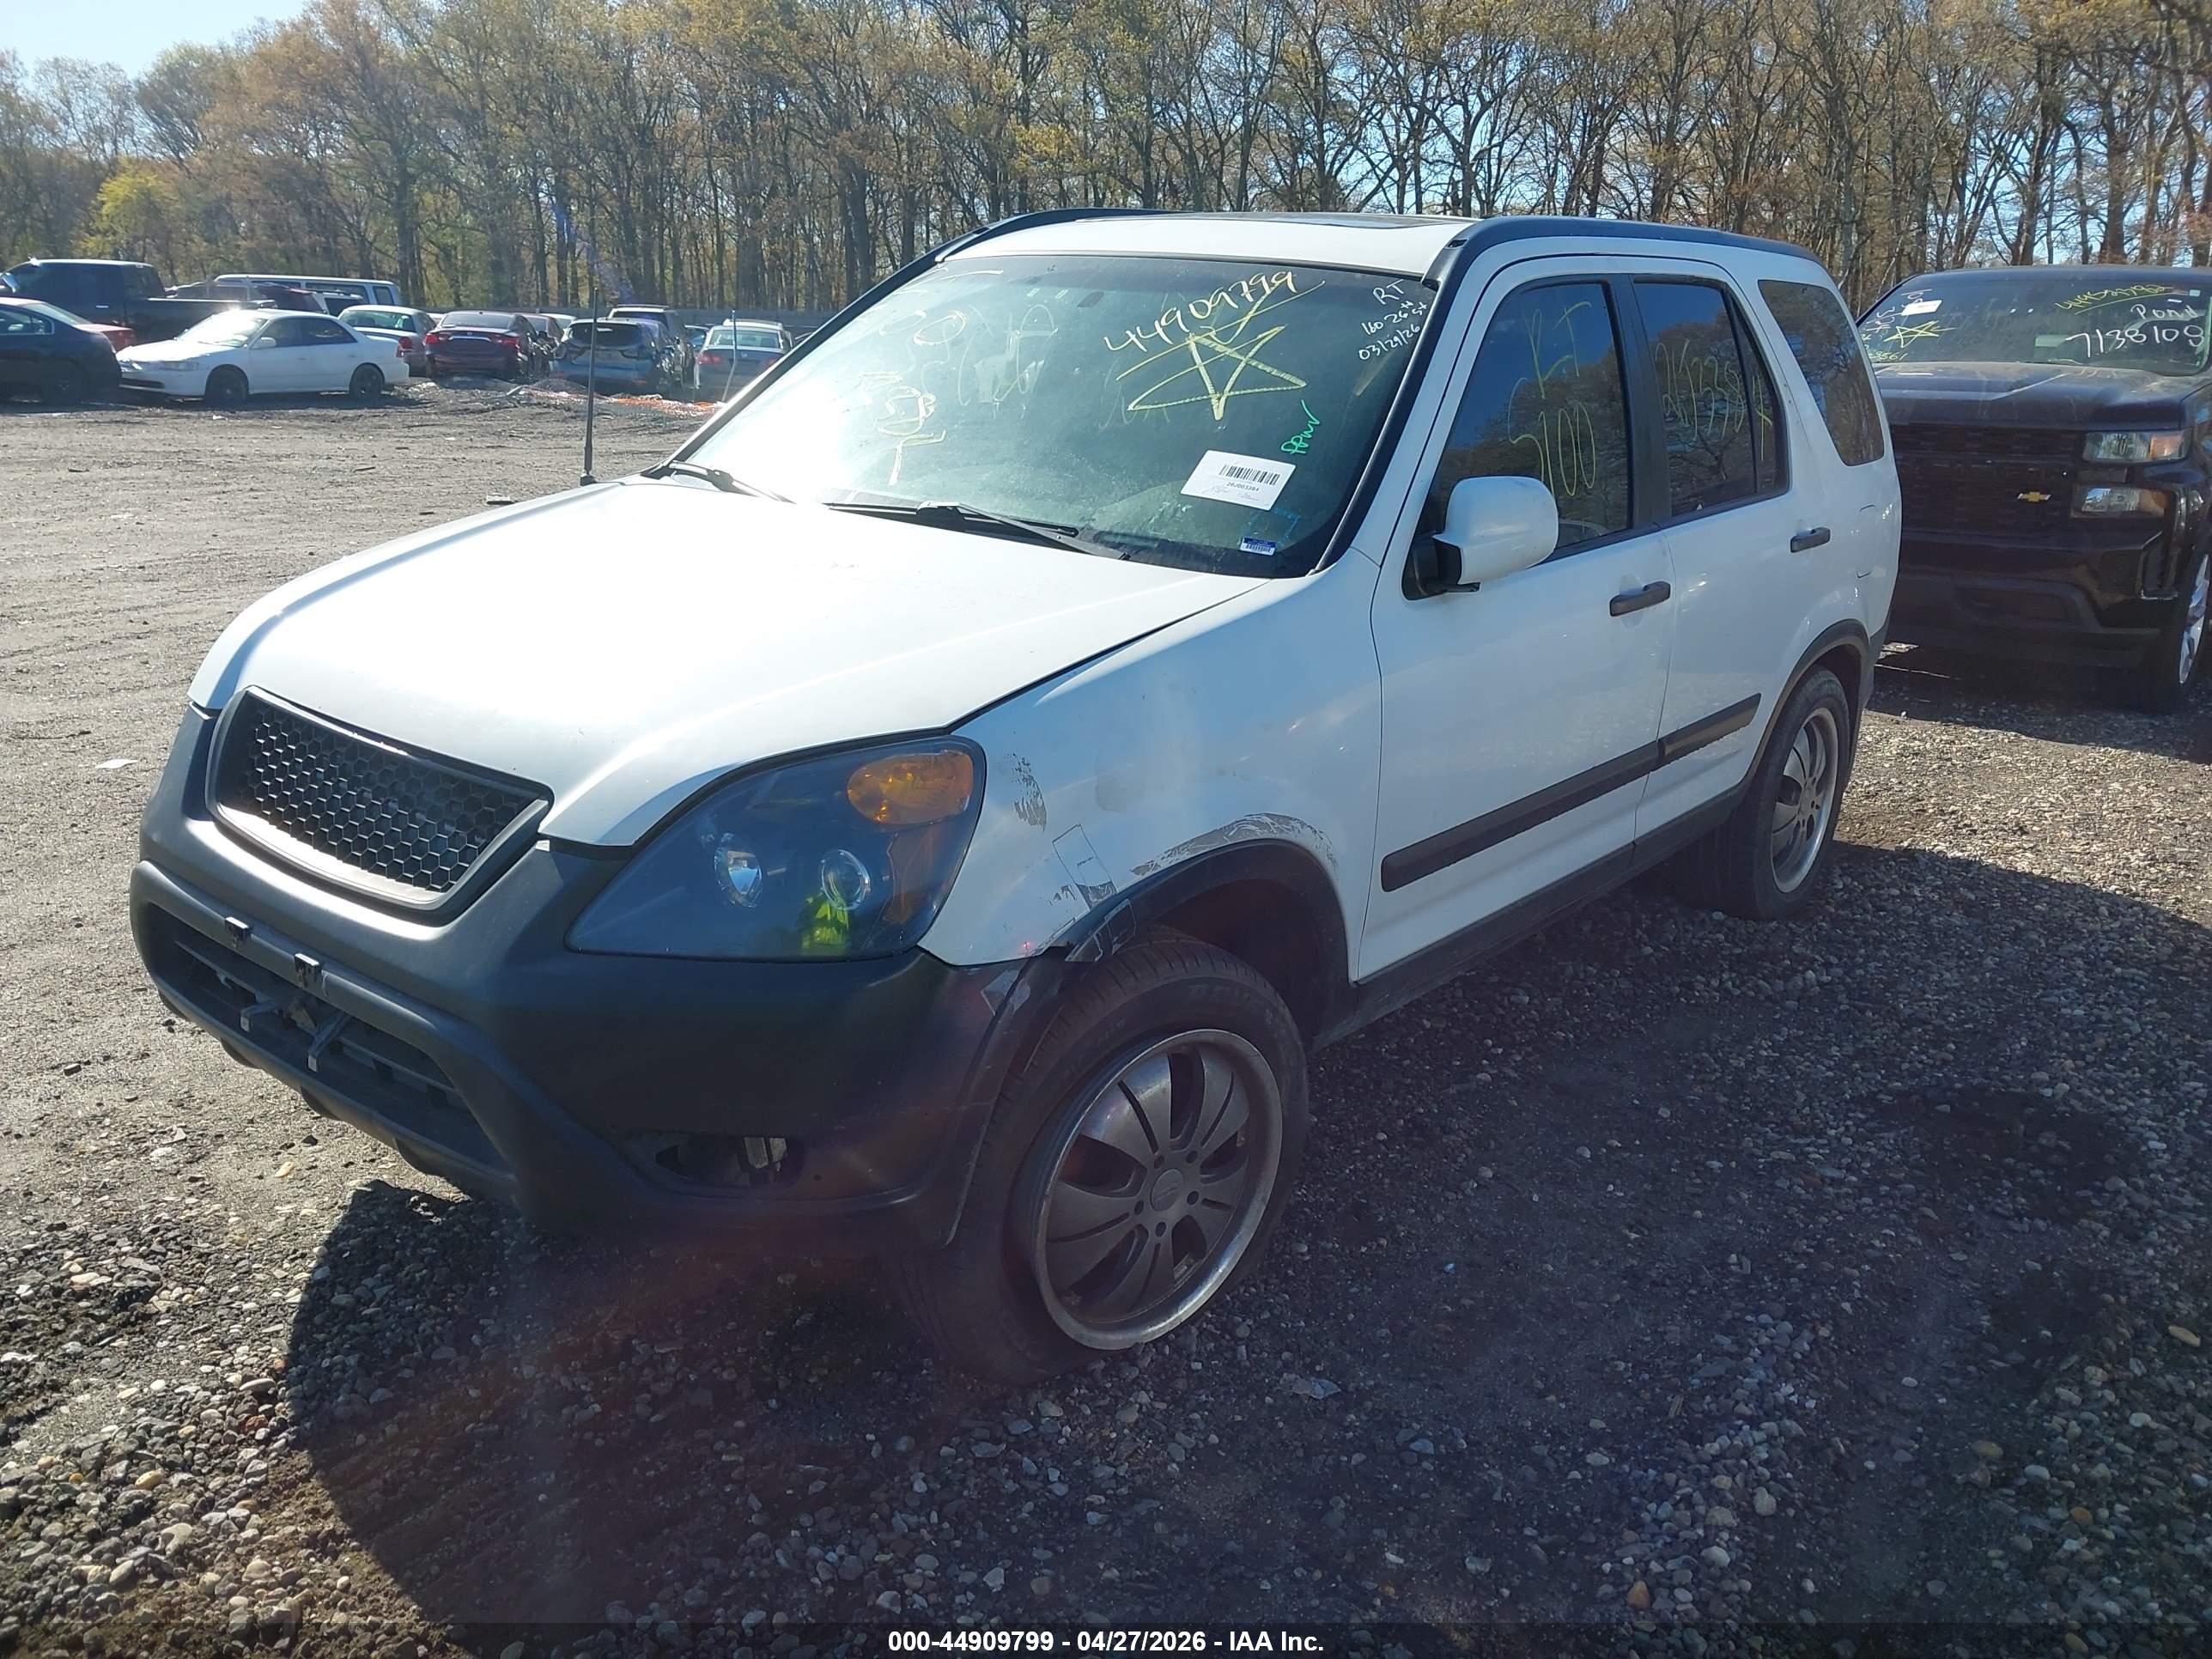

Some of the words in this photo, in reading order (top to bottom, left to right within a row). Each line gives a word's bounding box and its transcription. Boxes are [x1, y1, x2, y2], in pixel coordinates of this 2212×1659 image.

[1372, 278, 1405, 306] RT
[1103, 270, 1298, 352] 44909799
[1358, 323, 1421, 360] 03/29/26
